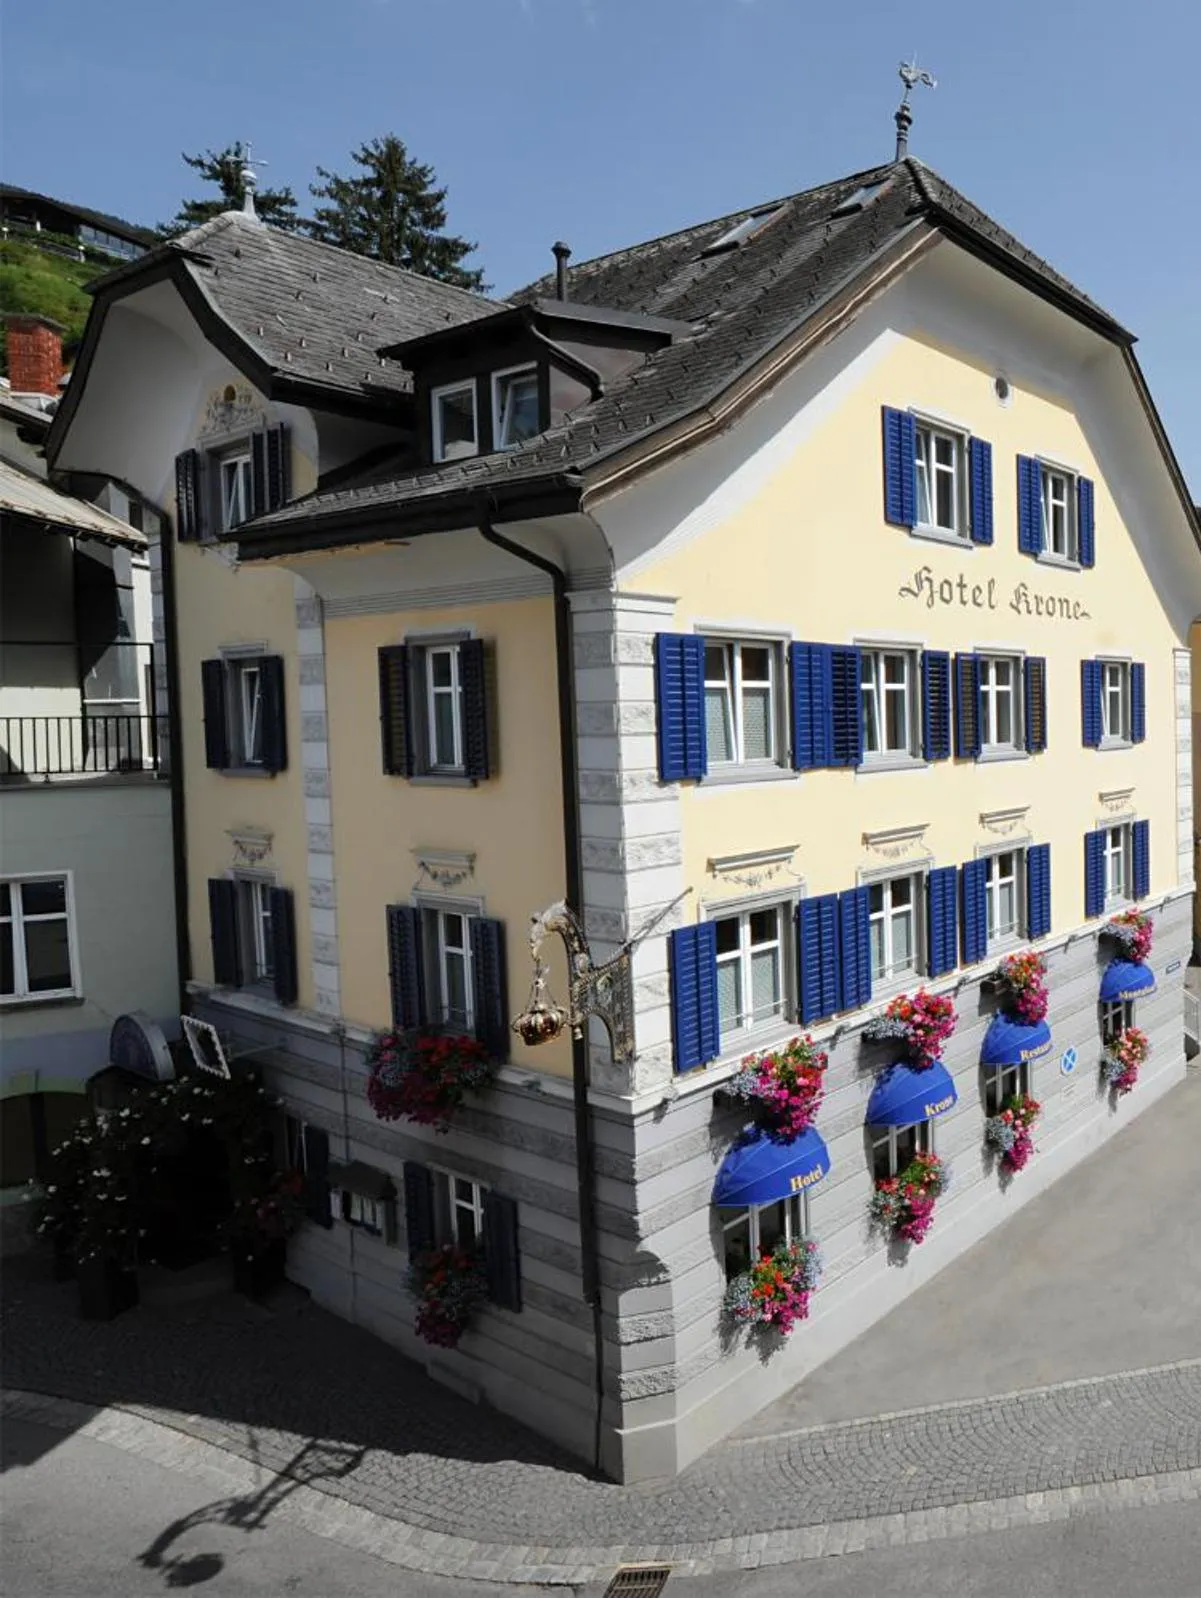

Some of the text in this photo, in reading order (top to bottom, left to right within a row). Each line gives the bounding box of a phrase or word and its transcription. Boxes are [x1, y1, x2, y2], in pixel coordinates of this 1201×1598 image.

[898, 565, 1092, 620] Hotel Krone
[791, 1163, 823, 1192] Hotel
